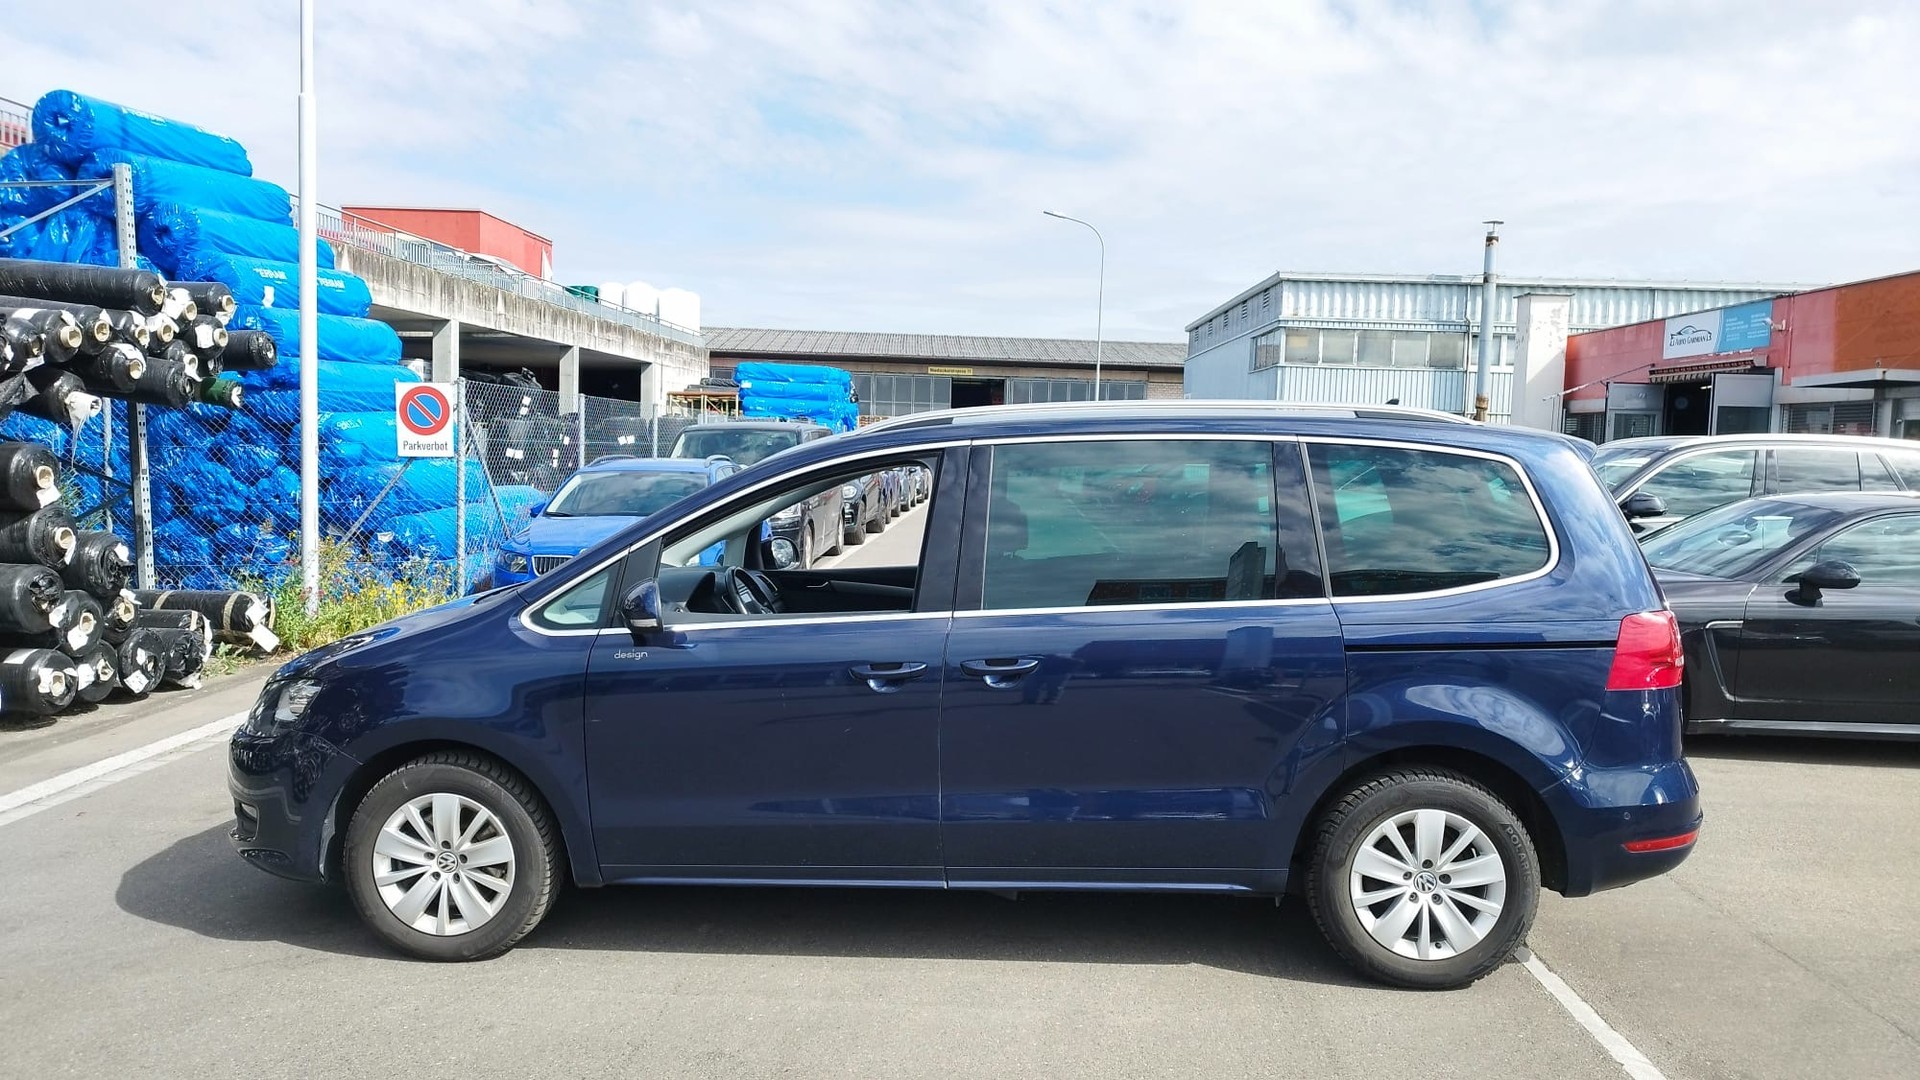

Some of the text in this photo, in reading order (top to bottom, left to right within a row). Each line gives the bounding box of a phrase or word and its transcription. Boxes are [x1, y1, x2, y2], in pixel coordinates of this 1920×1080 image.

[403, 440, 448, 451] Parkverbot
[614, 649, 648, 661] design
[1505, 826, 1532, 883] POLARIS
